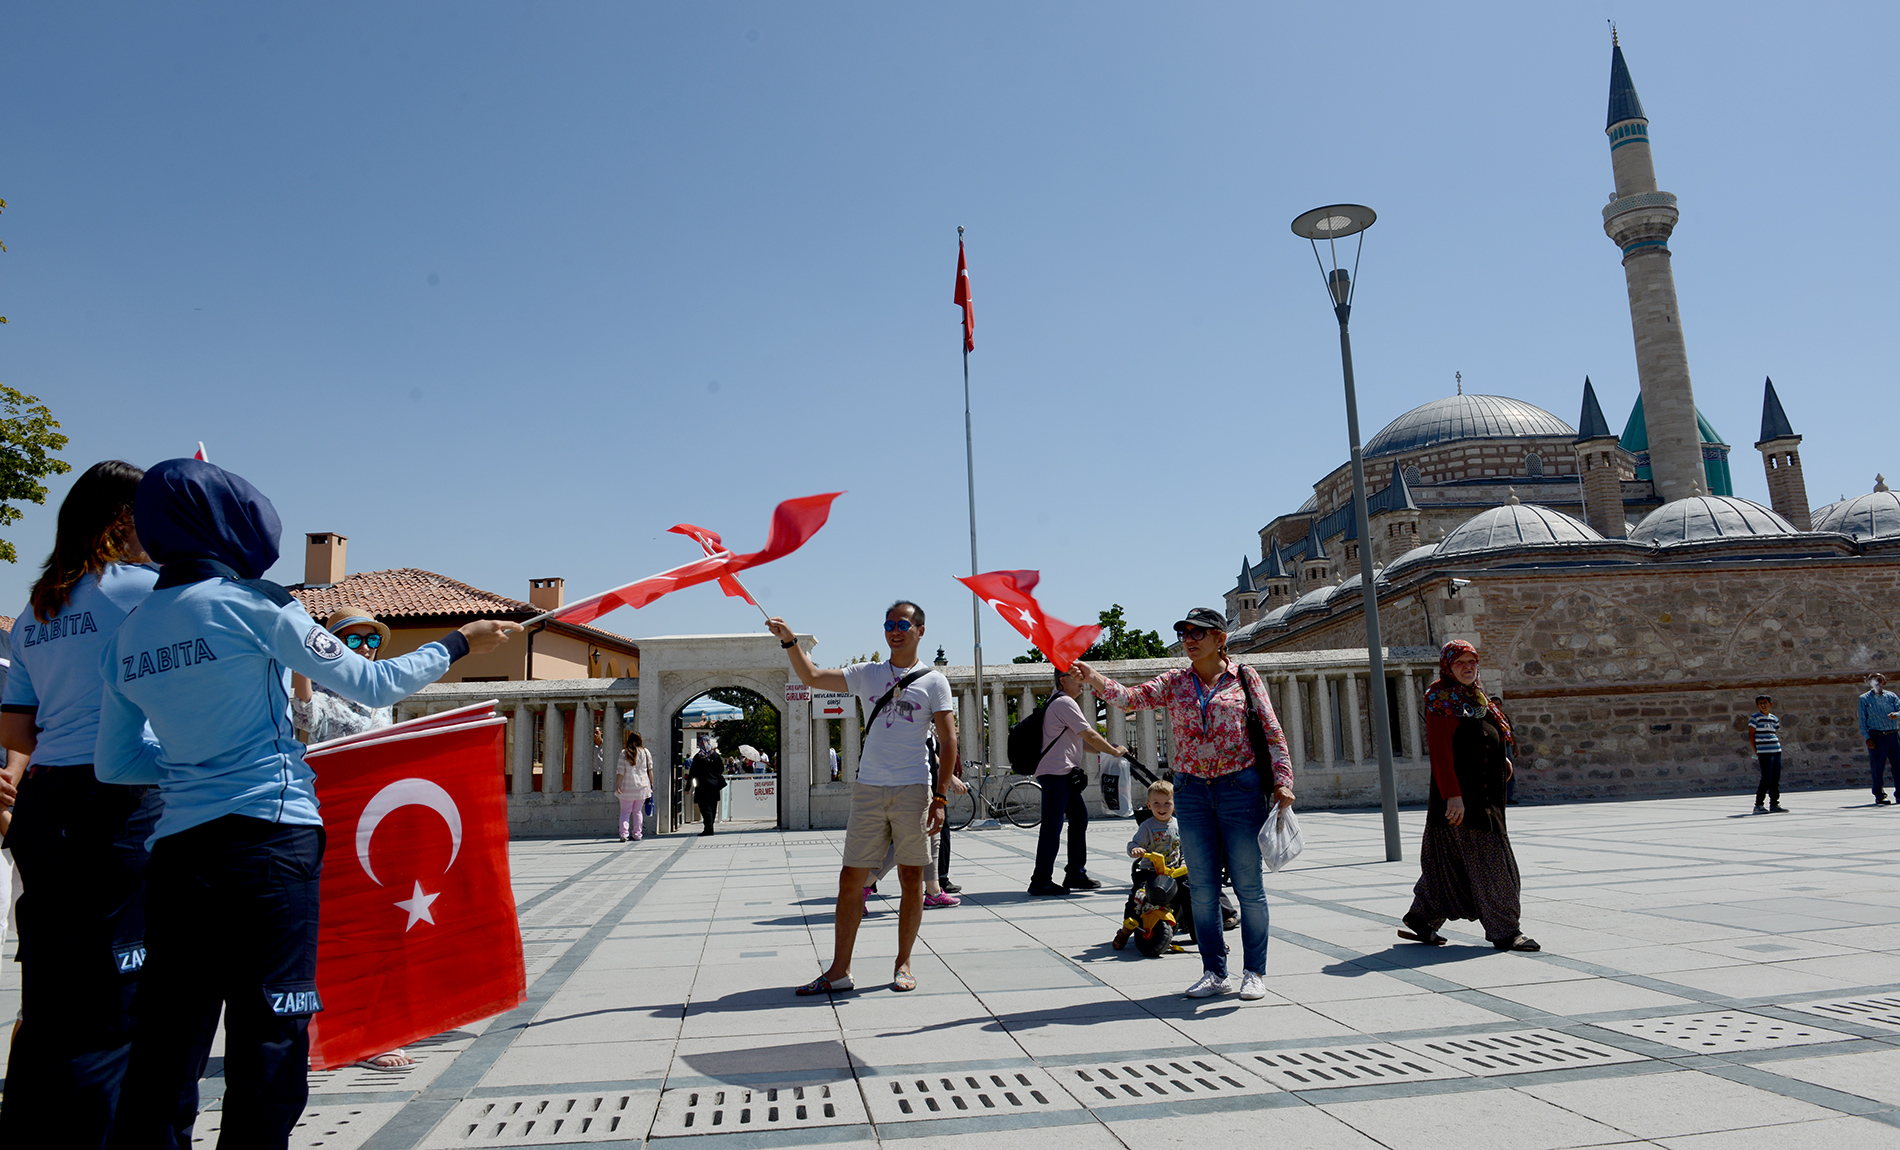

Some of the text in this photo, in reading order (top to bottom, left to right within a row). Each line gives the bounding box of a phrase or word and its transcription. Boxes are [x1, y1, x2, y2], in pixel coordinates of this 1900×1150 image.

[24, 611, 98, 648] ZABITA
[122, 637, 217, 682] ZABITA
[271, 991, 320, 1013] ZABITA
